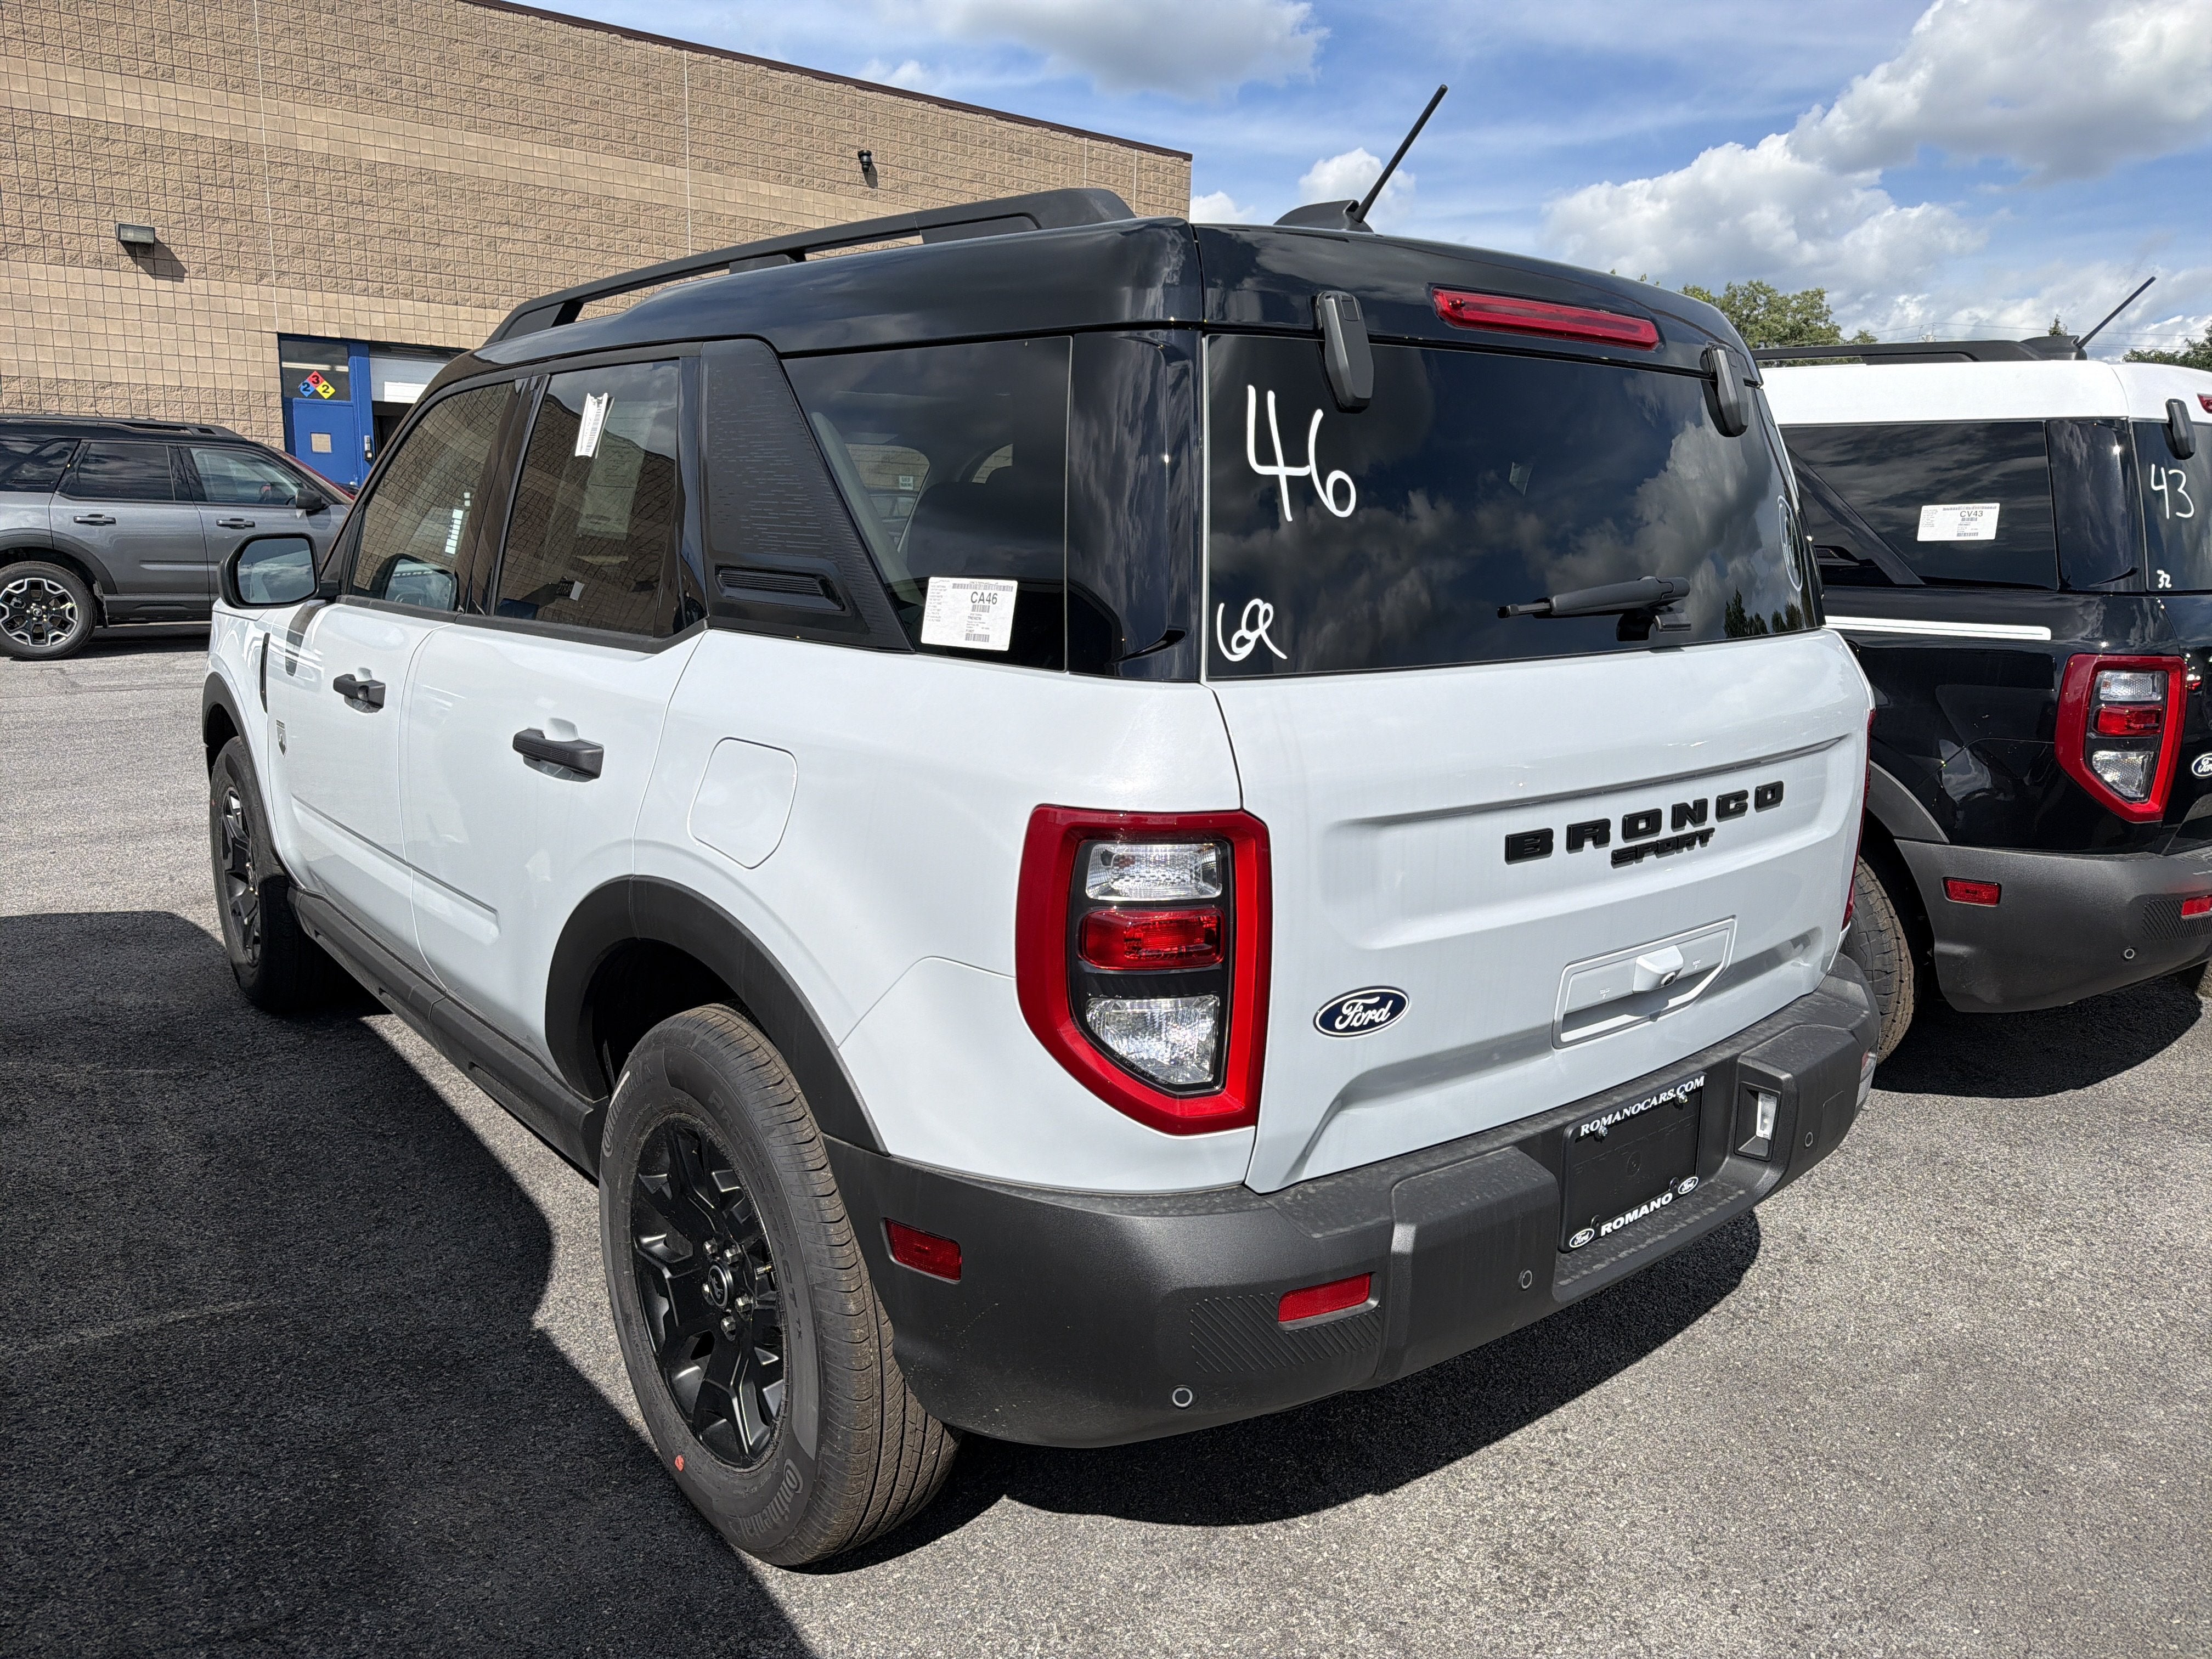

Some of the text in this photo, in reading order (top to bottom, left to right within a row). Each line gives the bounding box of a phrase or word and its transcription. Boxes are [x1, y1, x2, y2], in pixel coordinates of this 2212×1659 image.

[302, 382, 311, 392] 2
[311, 375, 320, 385] 3
[322, 385, 330, 393] 2
[1248, 385, 1356, 522] 46
[2151, 464, 2194, 519] 43
[2157, 570, 2172, 588] 32
[970, 591, 998, 605] CA46
[2198, 757, 2212, 773] For
[1505, 781, 1784, 864] BRONCO
[1611, 827, 1715, 868] SPORT
[1335, 996, 1393, 1030] Ford
[1580, 1075, 1705, 1137] ROMANOCARS.COM
[1681, 1180, 1695, 1192] Ford
[1600, 1193, 1673, 1237] ROMANO
[1574, 1231, 1590, 1245] Ford
